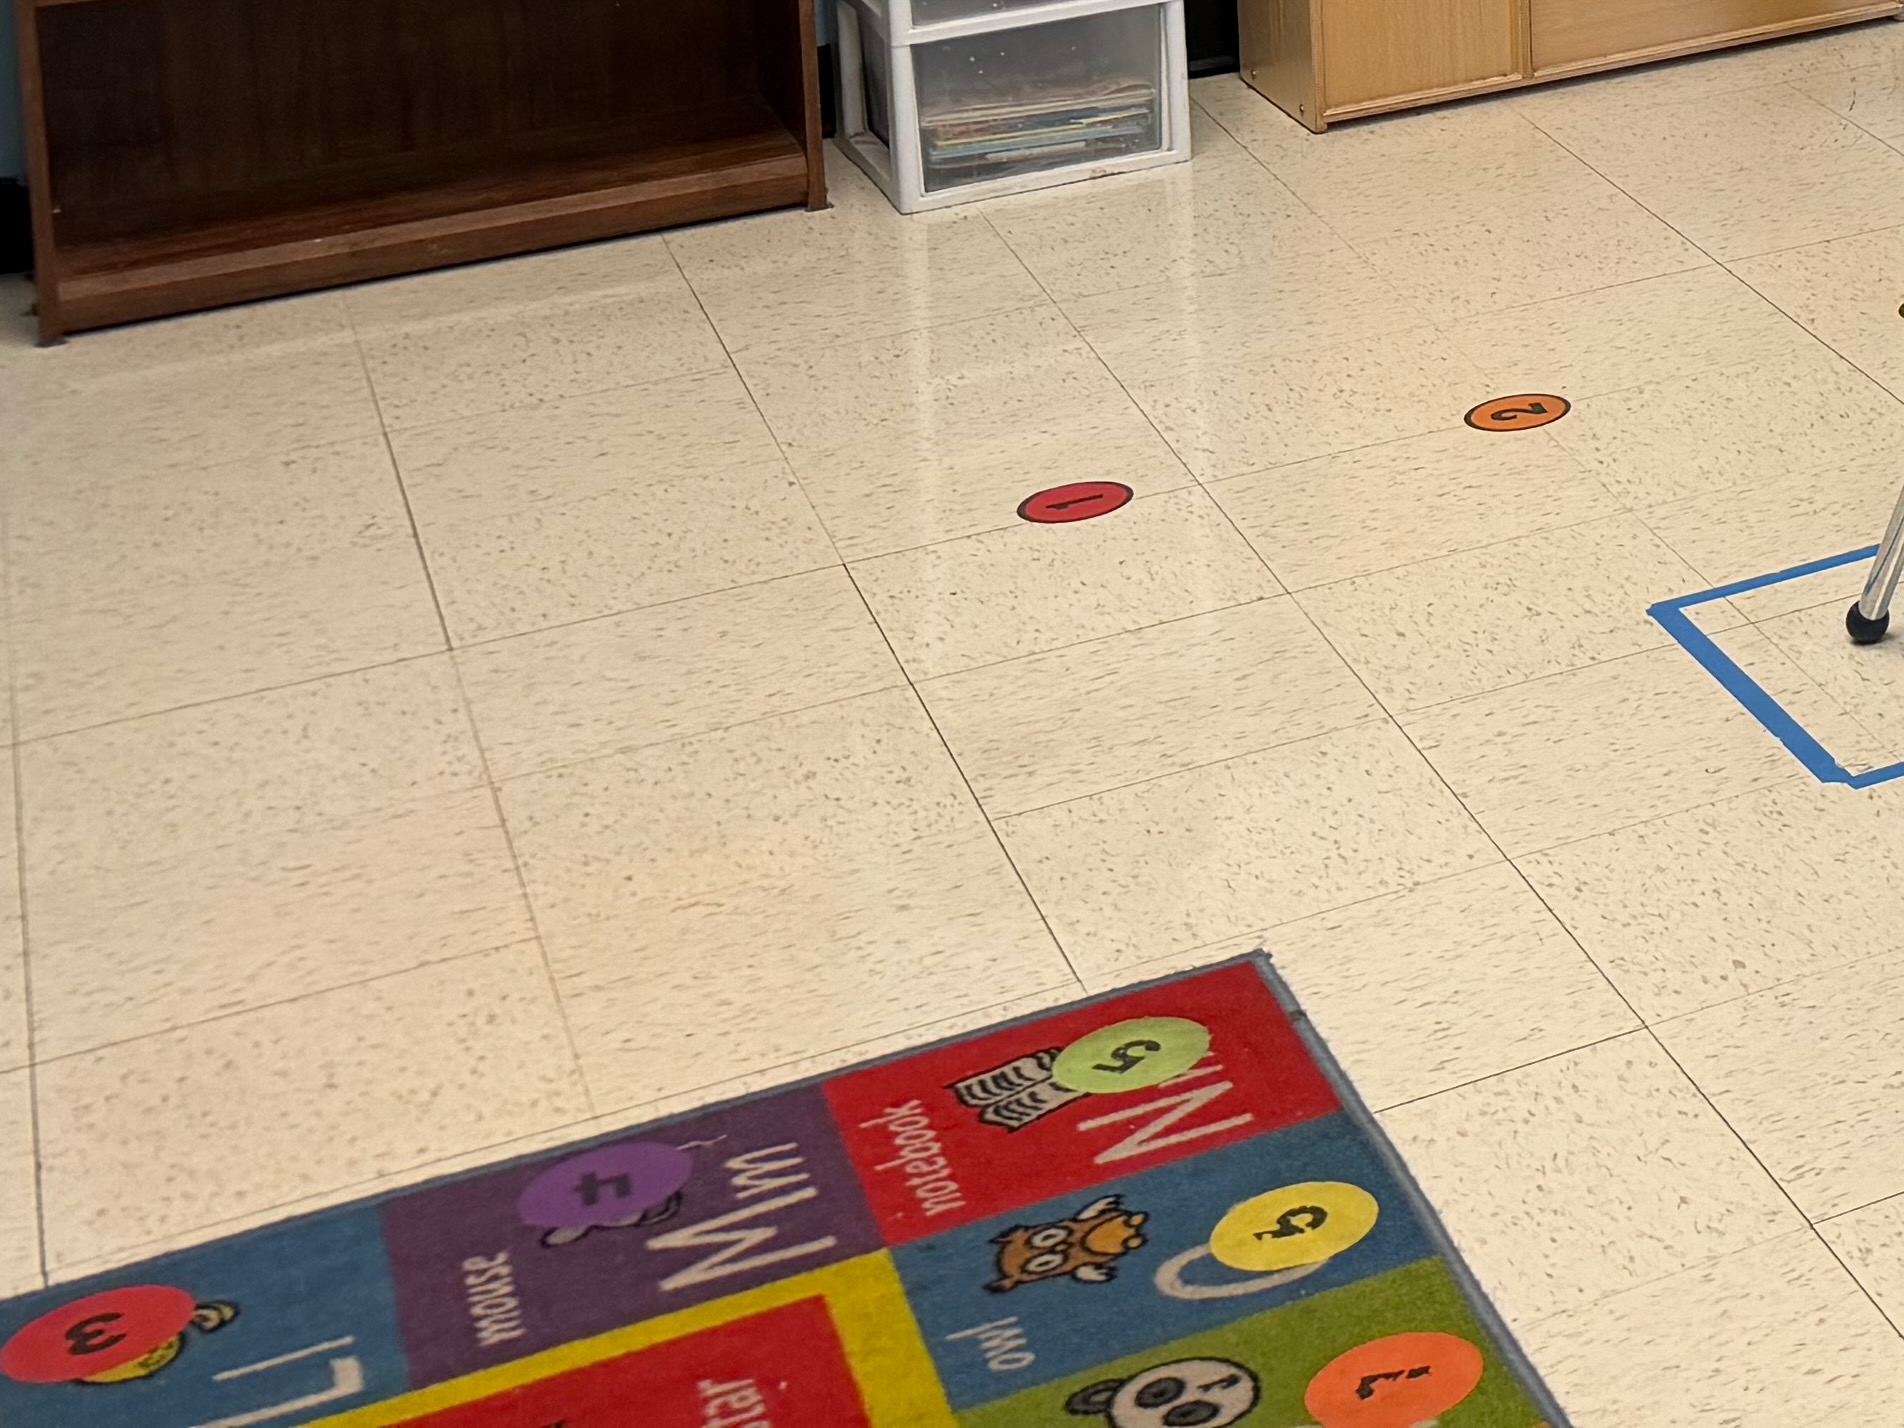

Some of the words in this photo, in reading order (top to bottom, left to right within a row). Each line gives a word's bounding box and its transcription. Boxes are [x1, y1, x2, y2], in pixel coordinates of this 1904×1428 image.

[1091, 1038, 1162, 1075] 5
[858, 1098, 965, 1218] notebook
[461, 1249, 522, 1347] mouse
[64, 1310, 128, 1356] 3
[946, 1316, 1036, 1372] owl
